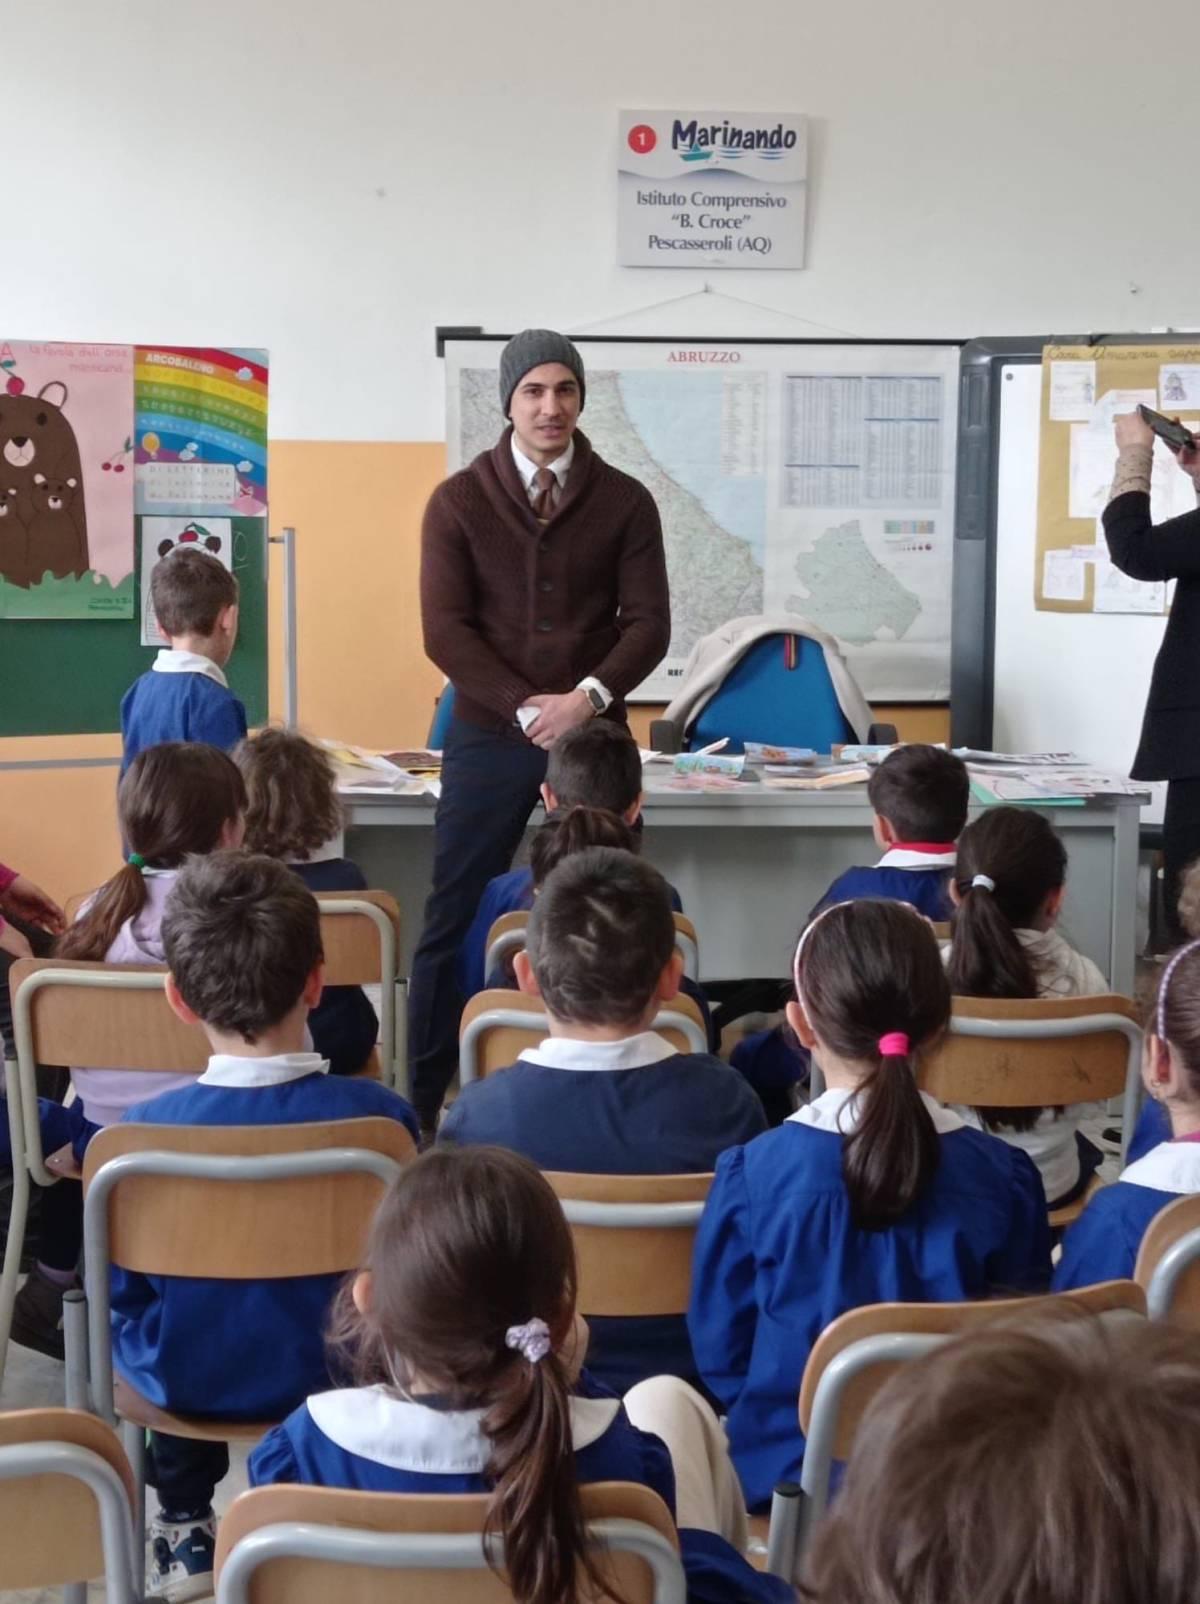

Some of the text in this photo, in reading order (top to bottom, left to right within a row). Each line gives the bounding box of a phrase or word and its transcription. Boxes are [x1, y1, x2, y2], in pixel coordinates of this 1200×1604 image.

[671, 119, 797, 150] Marinando
[636, 190, 787, 211] Istituto Comprensivo
[648, 235, 772, 255] Pescasseroli (AQ)
[145, 353, 215, 375] ARCOBALENO
[668, 350, 742, 363] ABRUZZO
